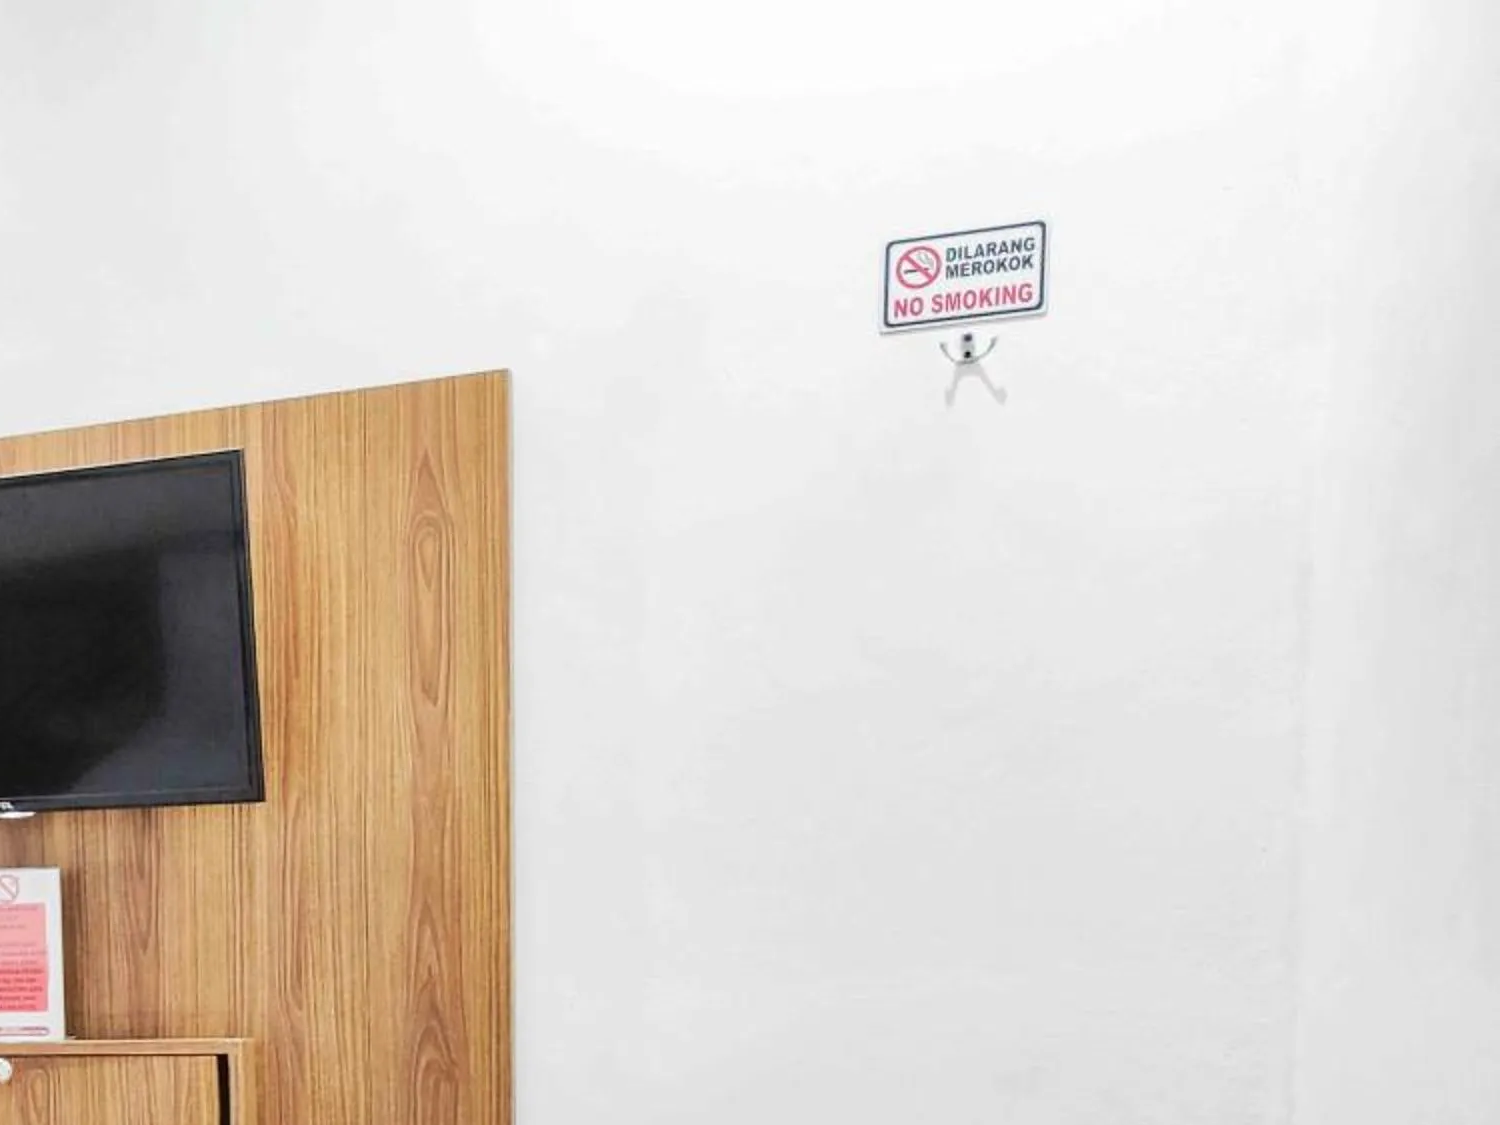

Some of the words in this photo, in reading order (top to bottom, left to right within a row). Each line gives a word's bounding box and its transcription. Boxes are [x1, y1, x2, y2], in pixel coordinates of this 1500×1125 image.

[945, 237, 1036, 263] DILARANG
[945, 254, 1034, 280] MEROKOK
[893, 297, 924, 319] NO
[931, 282, 1033, 314] SMOKING
